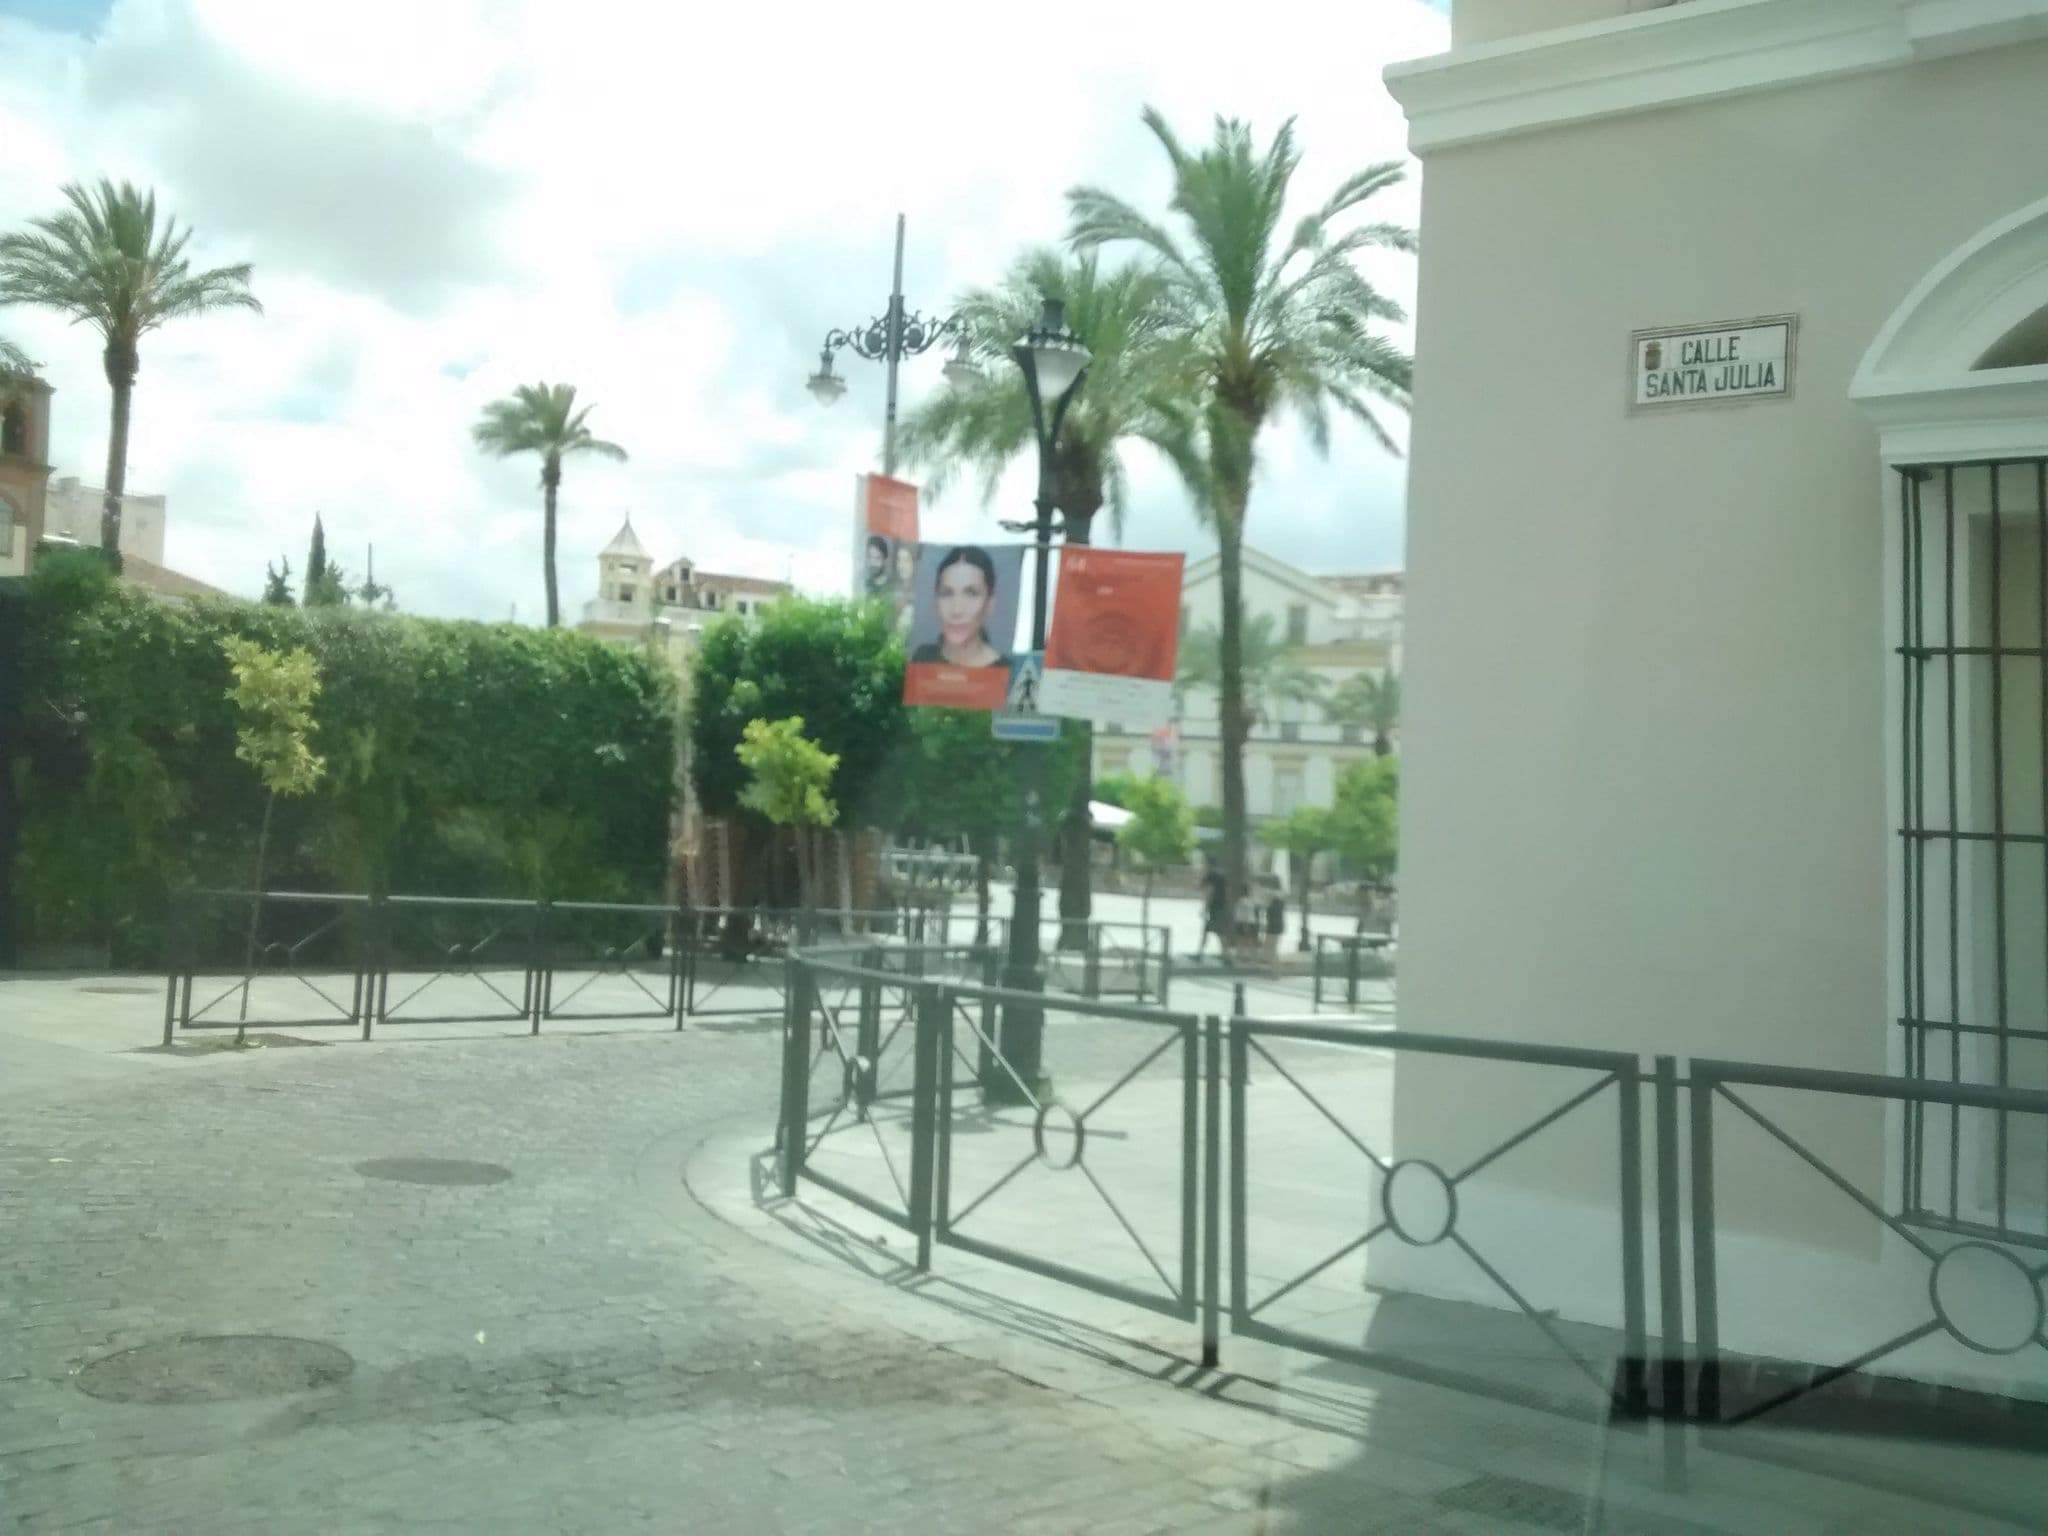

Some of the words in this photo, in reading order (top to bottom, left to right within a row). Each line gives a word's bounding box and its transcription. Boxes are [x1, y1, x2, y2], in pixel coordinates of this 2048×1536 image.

[1681, 336, 1740, 365] CALLE
[1646, 369, 1708, 398] SANTA
[1714, 362, 1776, 391] JULIA
